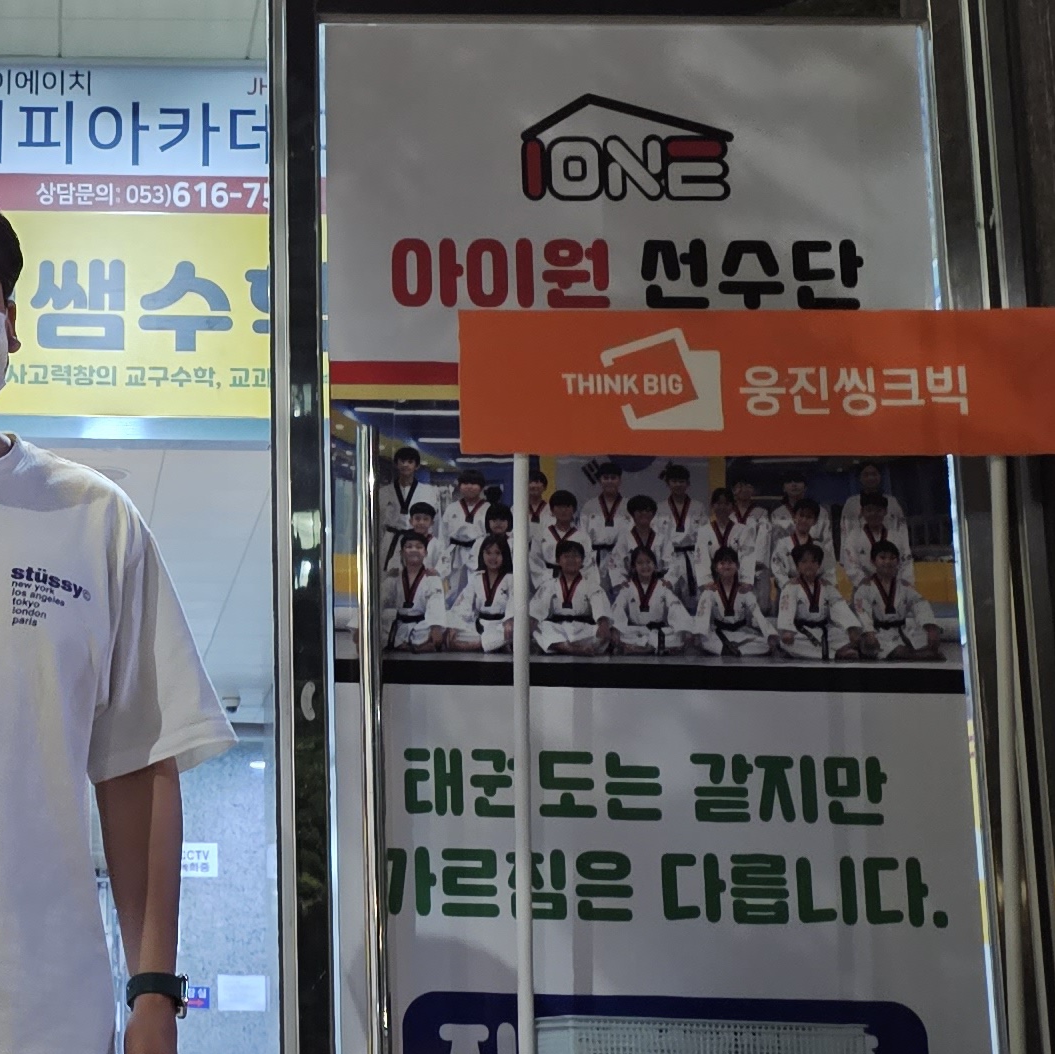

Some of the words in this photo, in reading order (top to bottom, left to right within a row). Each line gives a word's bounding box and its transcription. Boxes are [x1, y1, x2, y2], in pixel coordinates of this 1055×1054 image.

[391, 237, 611, 309] 아이원
[640, 237, 864, 310] 선수단
[30, 258, 270, 352] 쌤수
[125, 365, 222, 390] 교구수학,
[561, 372, 640, 395] THINK
[643, 372, 684, 396] BIG
[739, 364, 969, 417] 웅진씽크빅
[11, 580, 32, 589] new
[34, 583, 55, 595] york
[11, 588, 27, 597] los
[30, 591, 65, 607] angeles
[12, 597, 40, 608] tokyo
[12, 607, 47, 619] london
[11, 616, 38, 627] paris
[689, 752, 887, 827] 같지만
[660, 851, 949, 928] 다릅니다.
